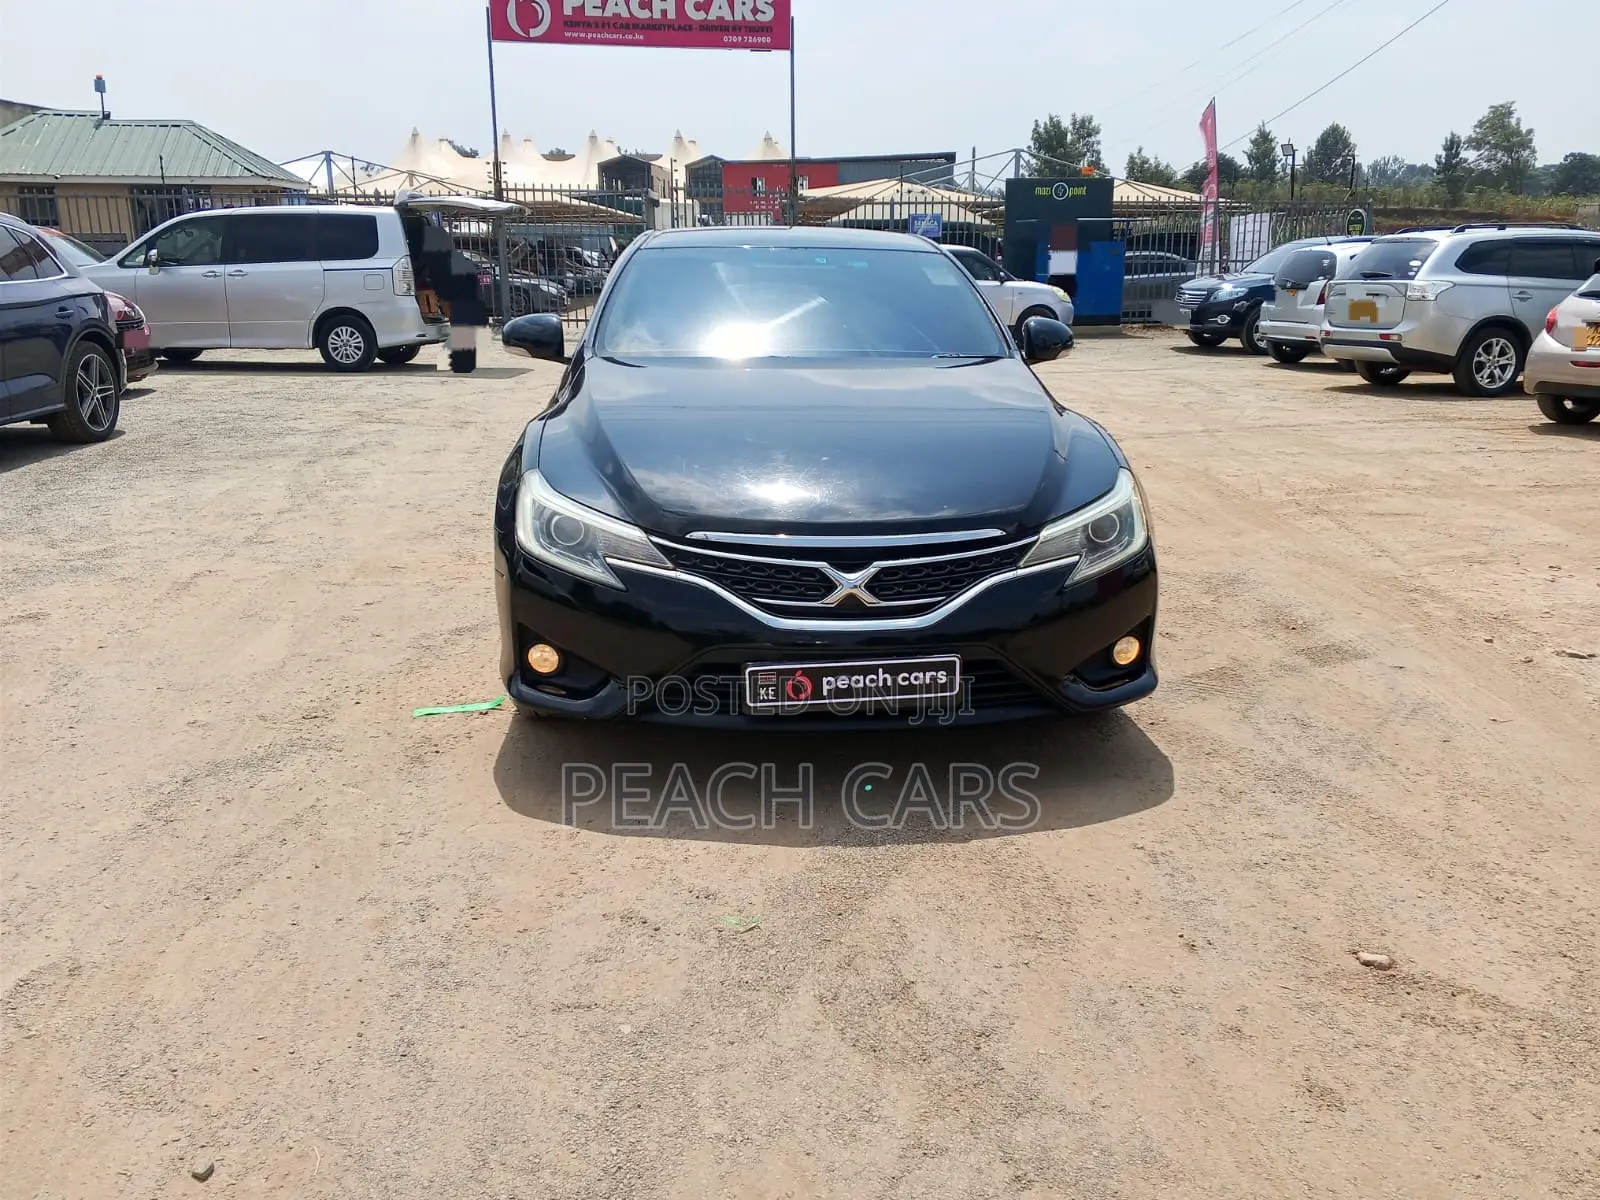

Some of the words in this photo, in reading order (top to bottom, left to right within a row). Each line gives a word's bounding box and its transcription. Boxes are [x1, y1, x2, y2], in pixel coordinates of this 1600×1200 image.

[563, 0, 676, 19] PEACH
[684, 0, 775, 21] CARS
[612, 21, 631, 30] CAR
[564, 31, 643, 40] www.peachcars.co.ke
[822, 668, 891, 696] peach
[898, 670, 947, 686] cars
[760, 687, 776, 700] KE
